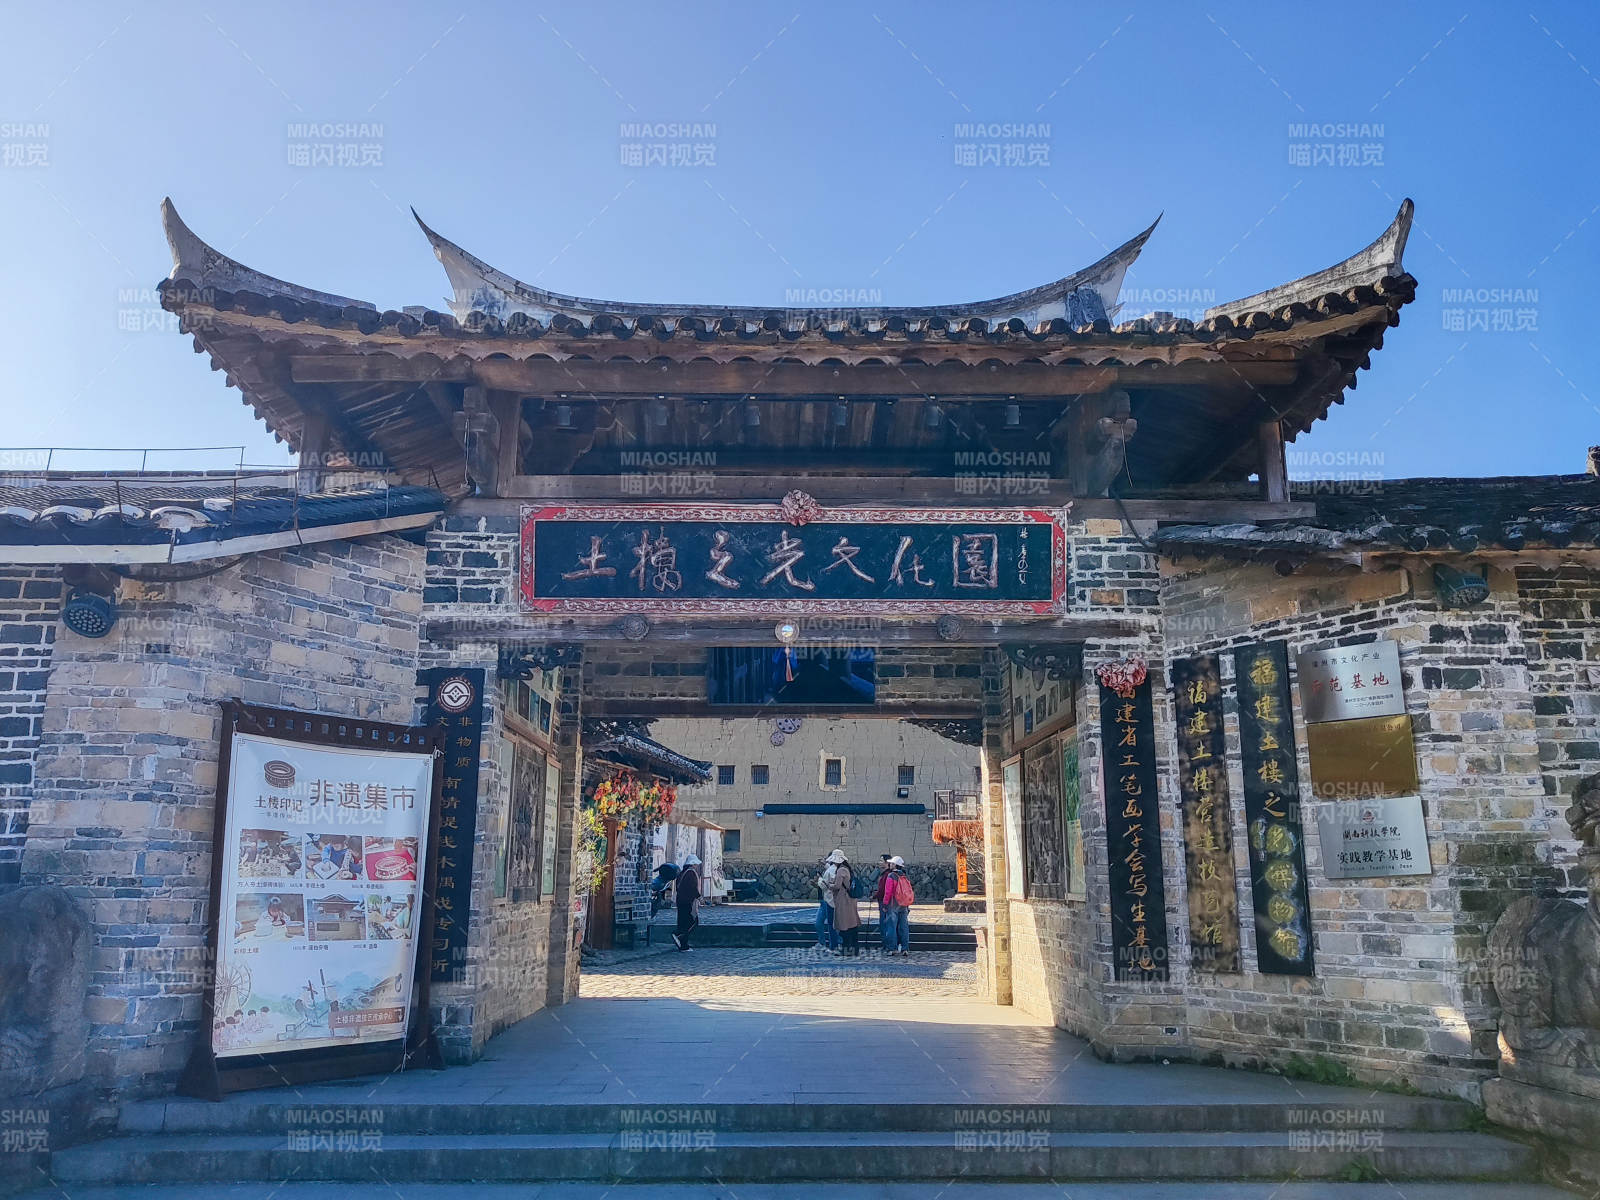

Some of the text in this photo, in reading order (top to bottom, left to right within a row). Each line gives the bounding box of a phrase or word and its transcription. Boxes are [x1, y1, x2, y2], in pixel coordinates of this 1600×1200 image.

[1312, 672, 1389, 695] 示范基地
[254, 795, 303, 812] 土楼印记
[309, 779, 416, 811] 非遗集市
[1337, 849, 1412, 864] 实践教学基地
